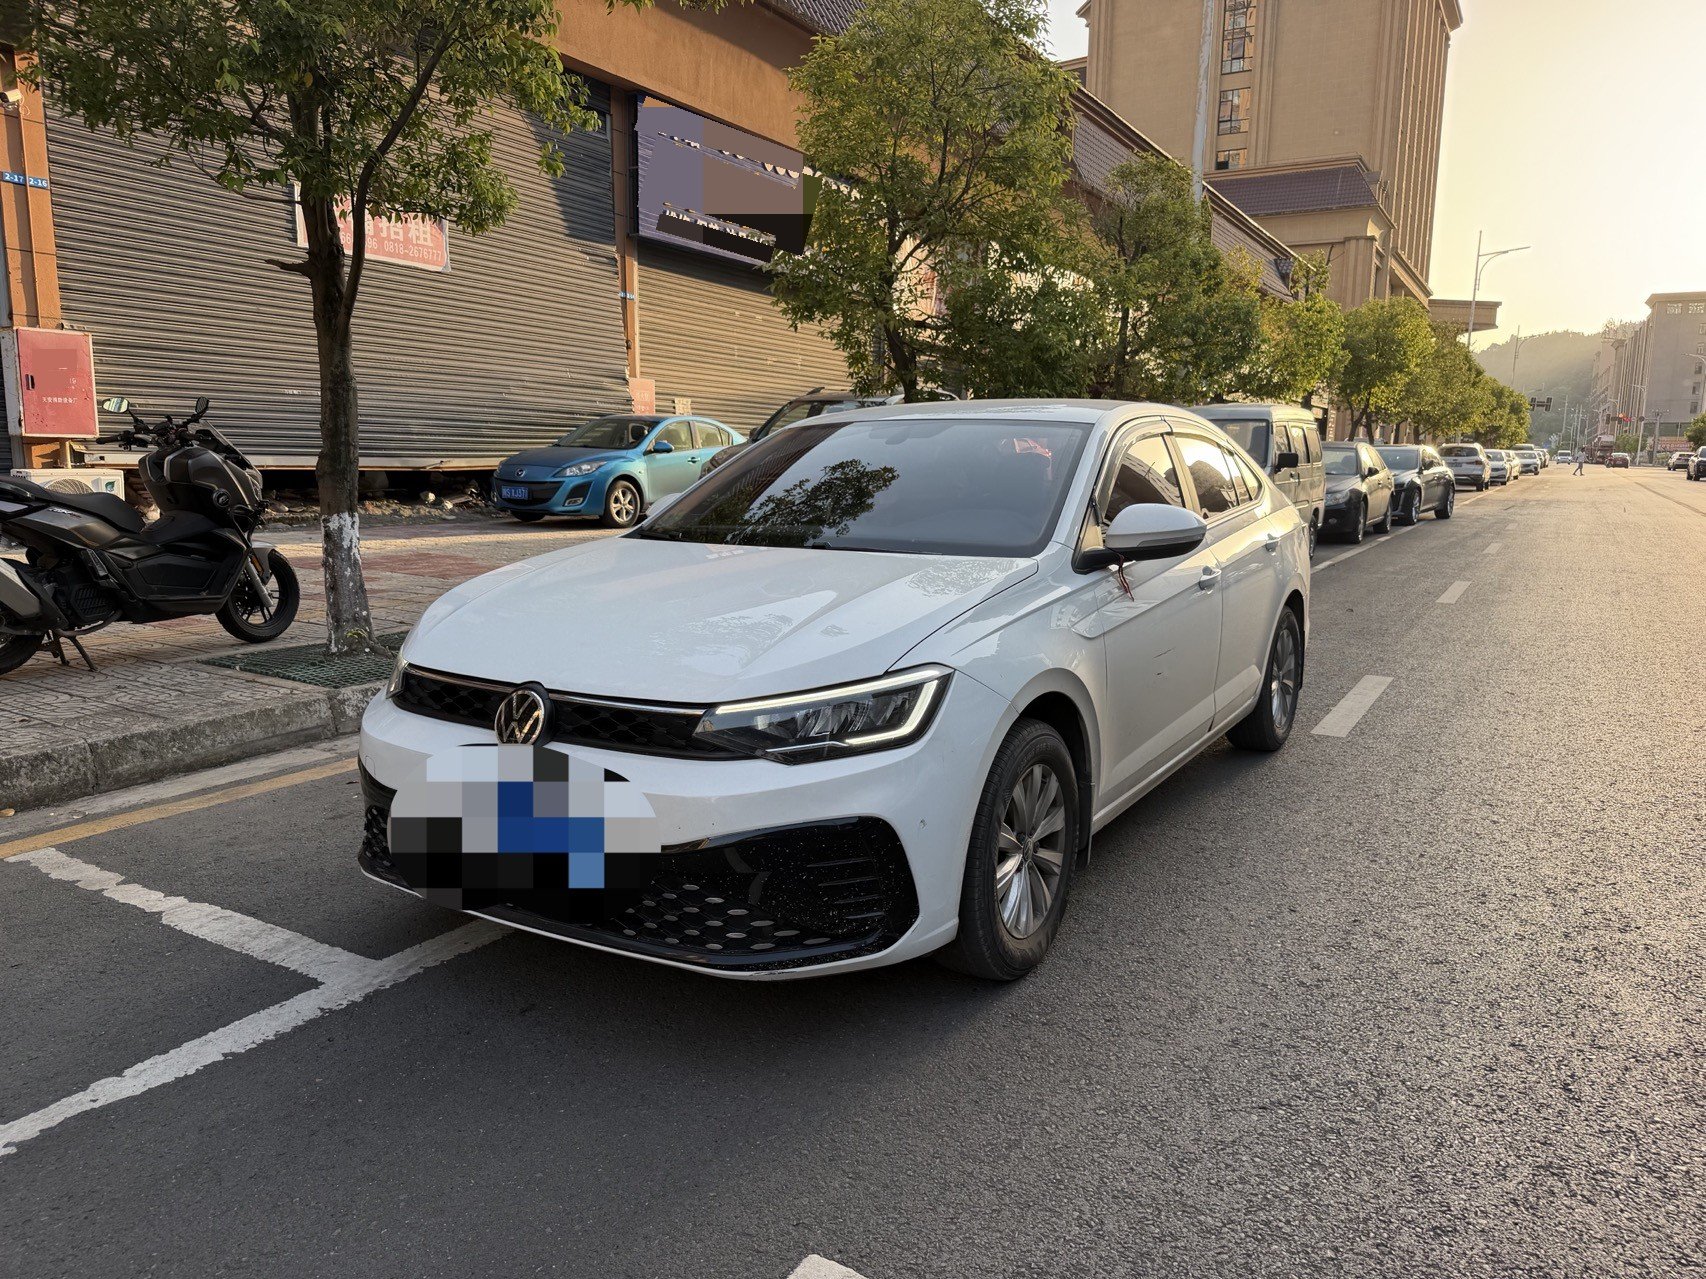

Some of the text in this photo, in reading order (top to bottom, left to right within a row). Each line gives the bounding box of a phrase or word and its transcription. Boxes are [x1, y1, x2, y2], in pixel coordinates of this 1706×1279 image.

[4, 172, 48, 188] 2-17 2-16
[384, 240, 442, 261] 0818-2676777
